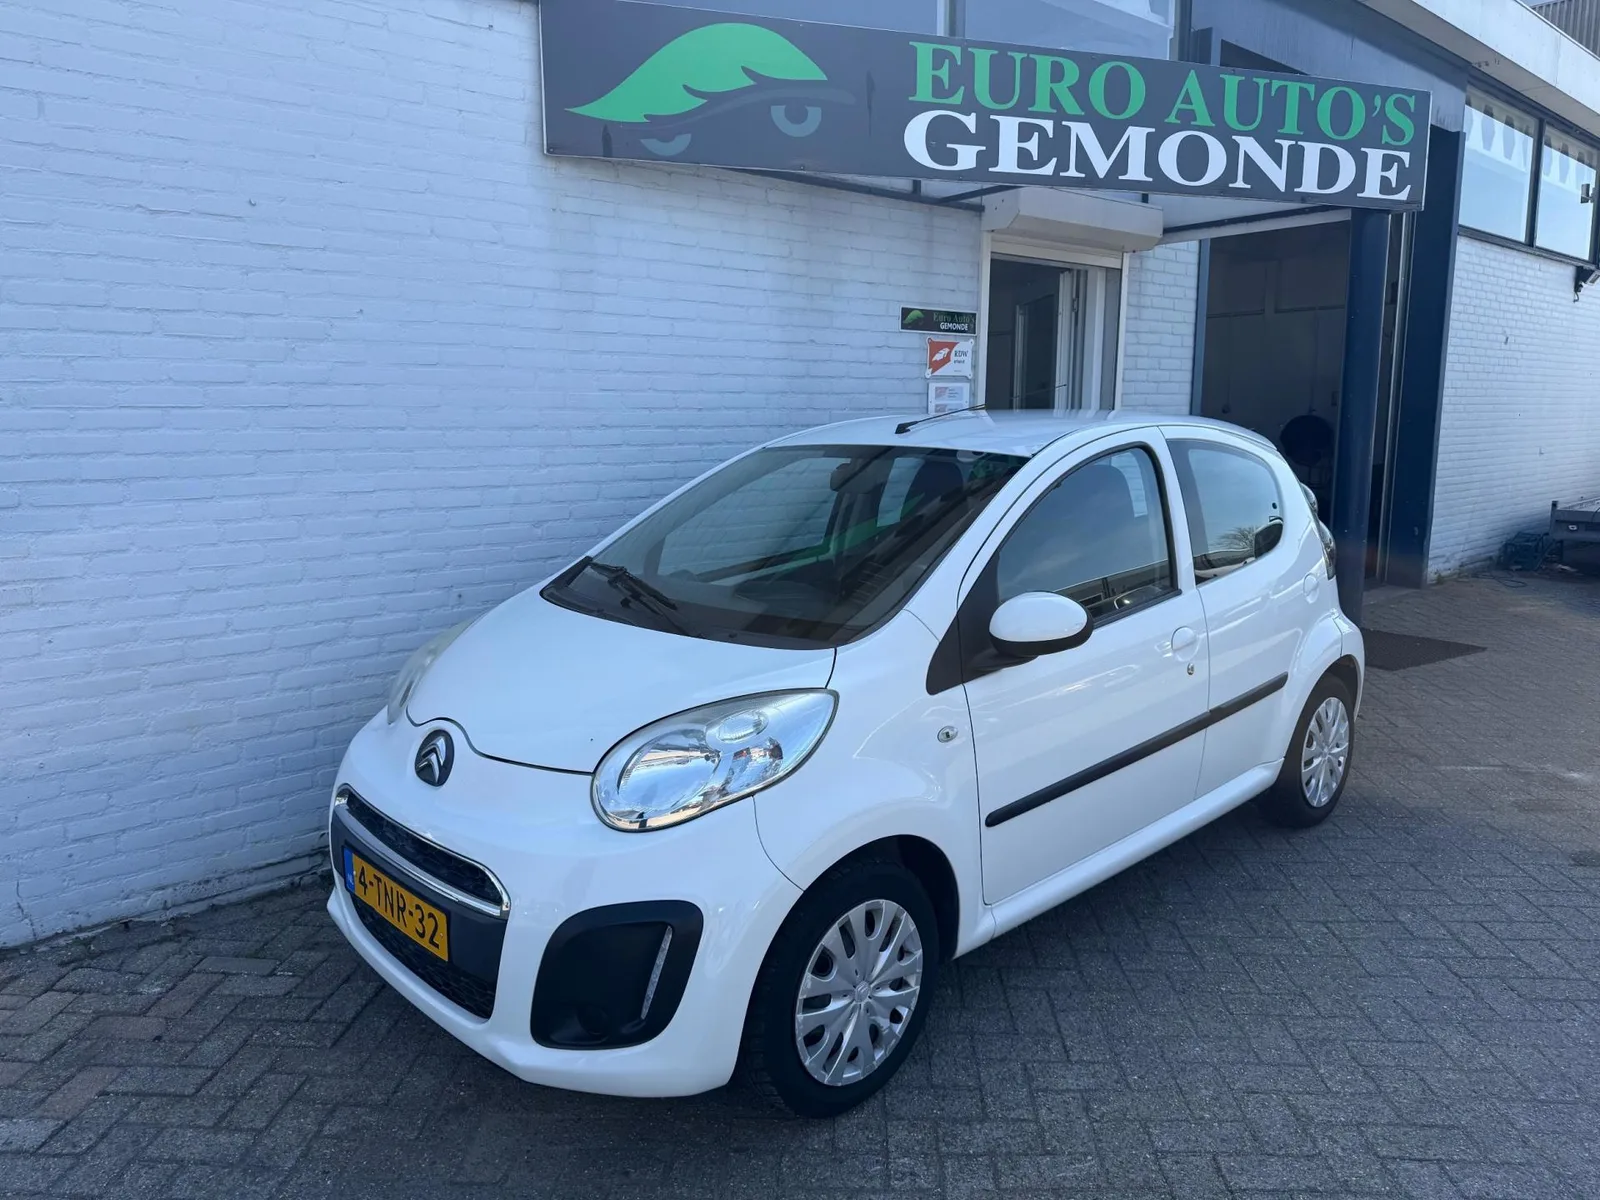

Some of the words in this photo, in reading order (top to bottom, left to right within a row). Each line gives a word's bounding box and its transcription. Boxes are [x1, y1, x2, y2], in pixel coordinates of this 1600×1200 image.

[908, 41, 1146, 119] EURO
[1164, 69, 1416, 146] AUTO'S
[903, 109, 1412, 201] GEMONDE
[940, 322, 969, 331] GEMONDE
[358, 865, 440, 949] 4-TNR-32
